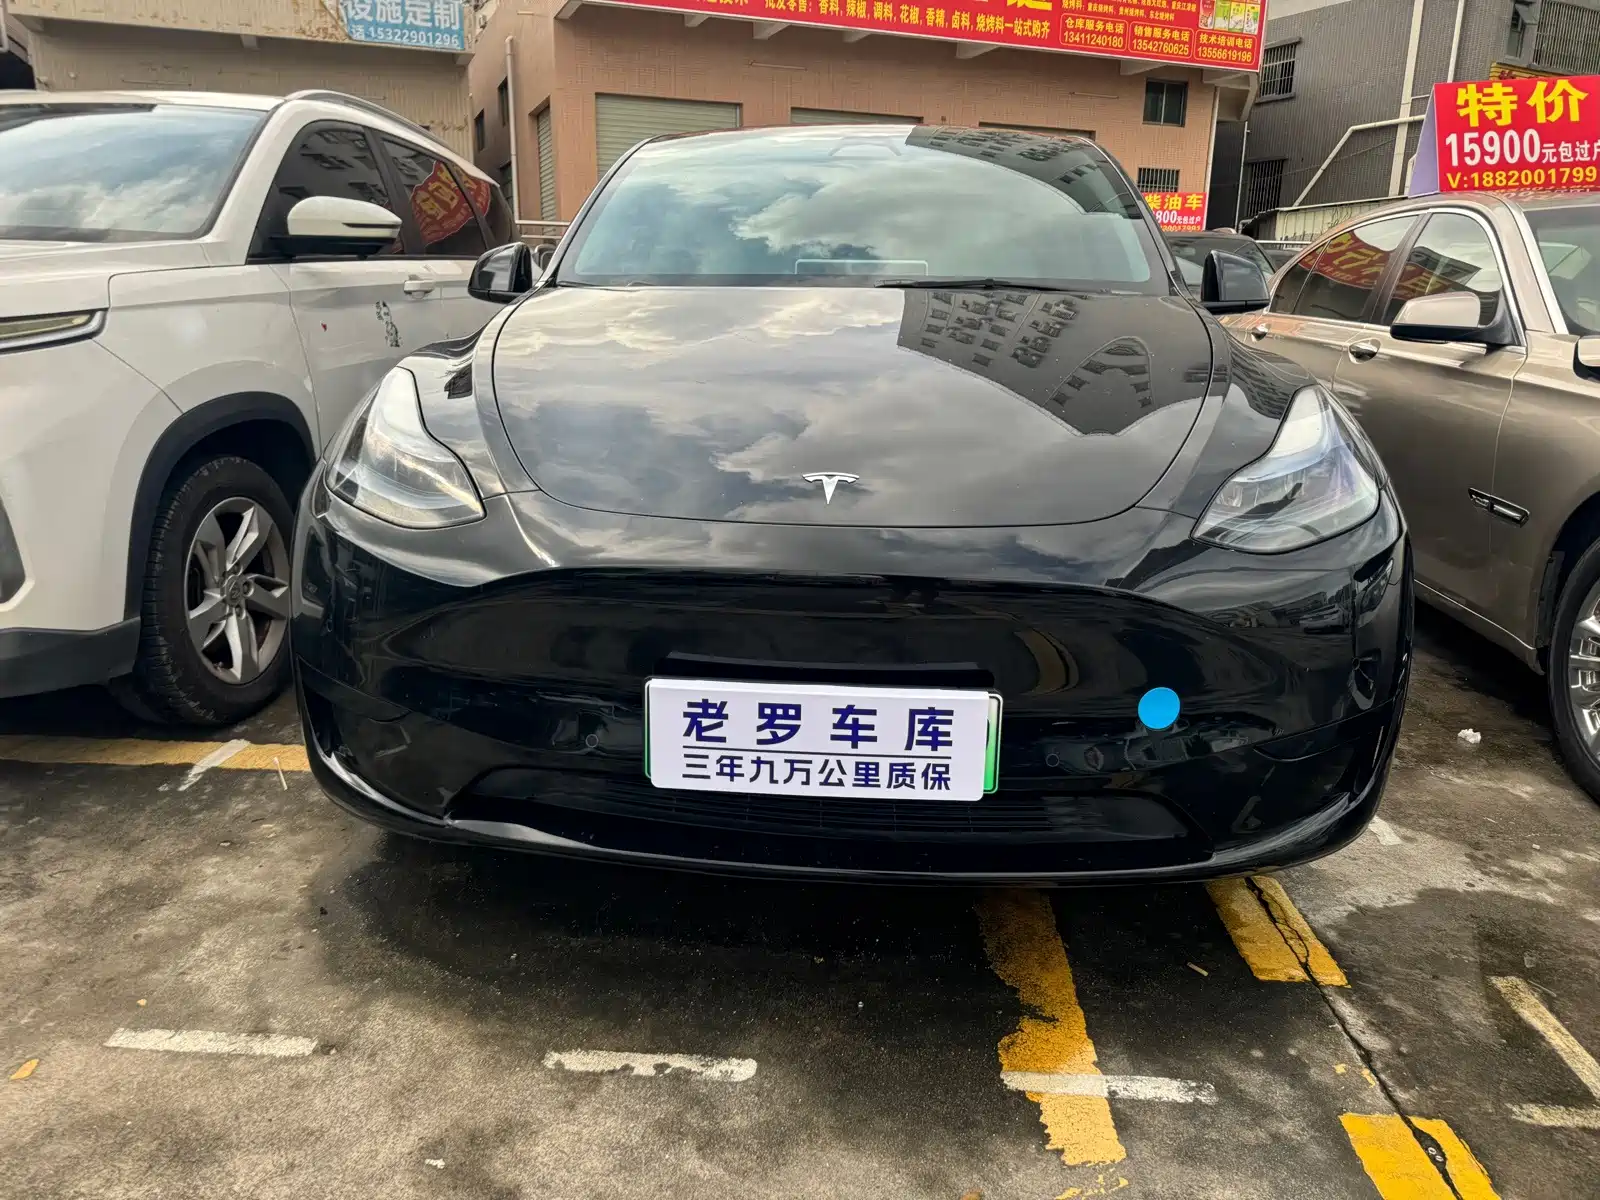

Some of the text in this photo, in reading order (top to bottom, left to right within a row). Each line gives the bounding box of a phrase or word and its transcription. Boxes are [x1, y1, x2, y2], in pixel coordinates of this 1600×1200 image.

[1065, 17, 1124, 34] 仓库服务电话
[1134, 25, 1190, 42] 销售服务电话
[369, 26, 460, 46] 15322901296
[1063, 31, 1123, 48] 13411240180
[1199, 32, 1252, 49] 技术培训电话
[1132, 39, 1189, 56] 13542760625
[1197, 46, 1252, 63] 13556619196
[1456, 79, 1589, 127] 特价
[1446, 166, 1597, 189] V:1882001799
[1144, 193, 1204, 210] 柴油车
[1153, 210, 1201, 225] 800元包过户
[682, 698, 954, 752] 老罗车库
[682, 753, 952, 791] 三年九万公里质保
